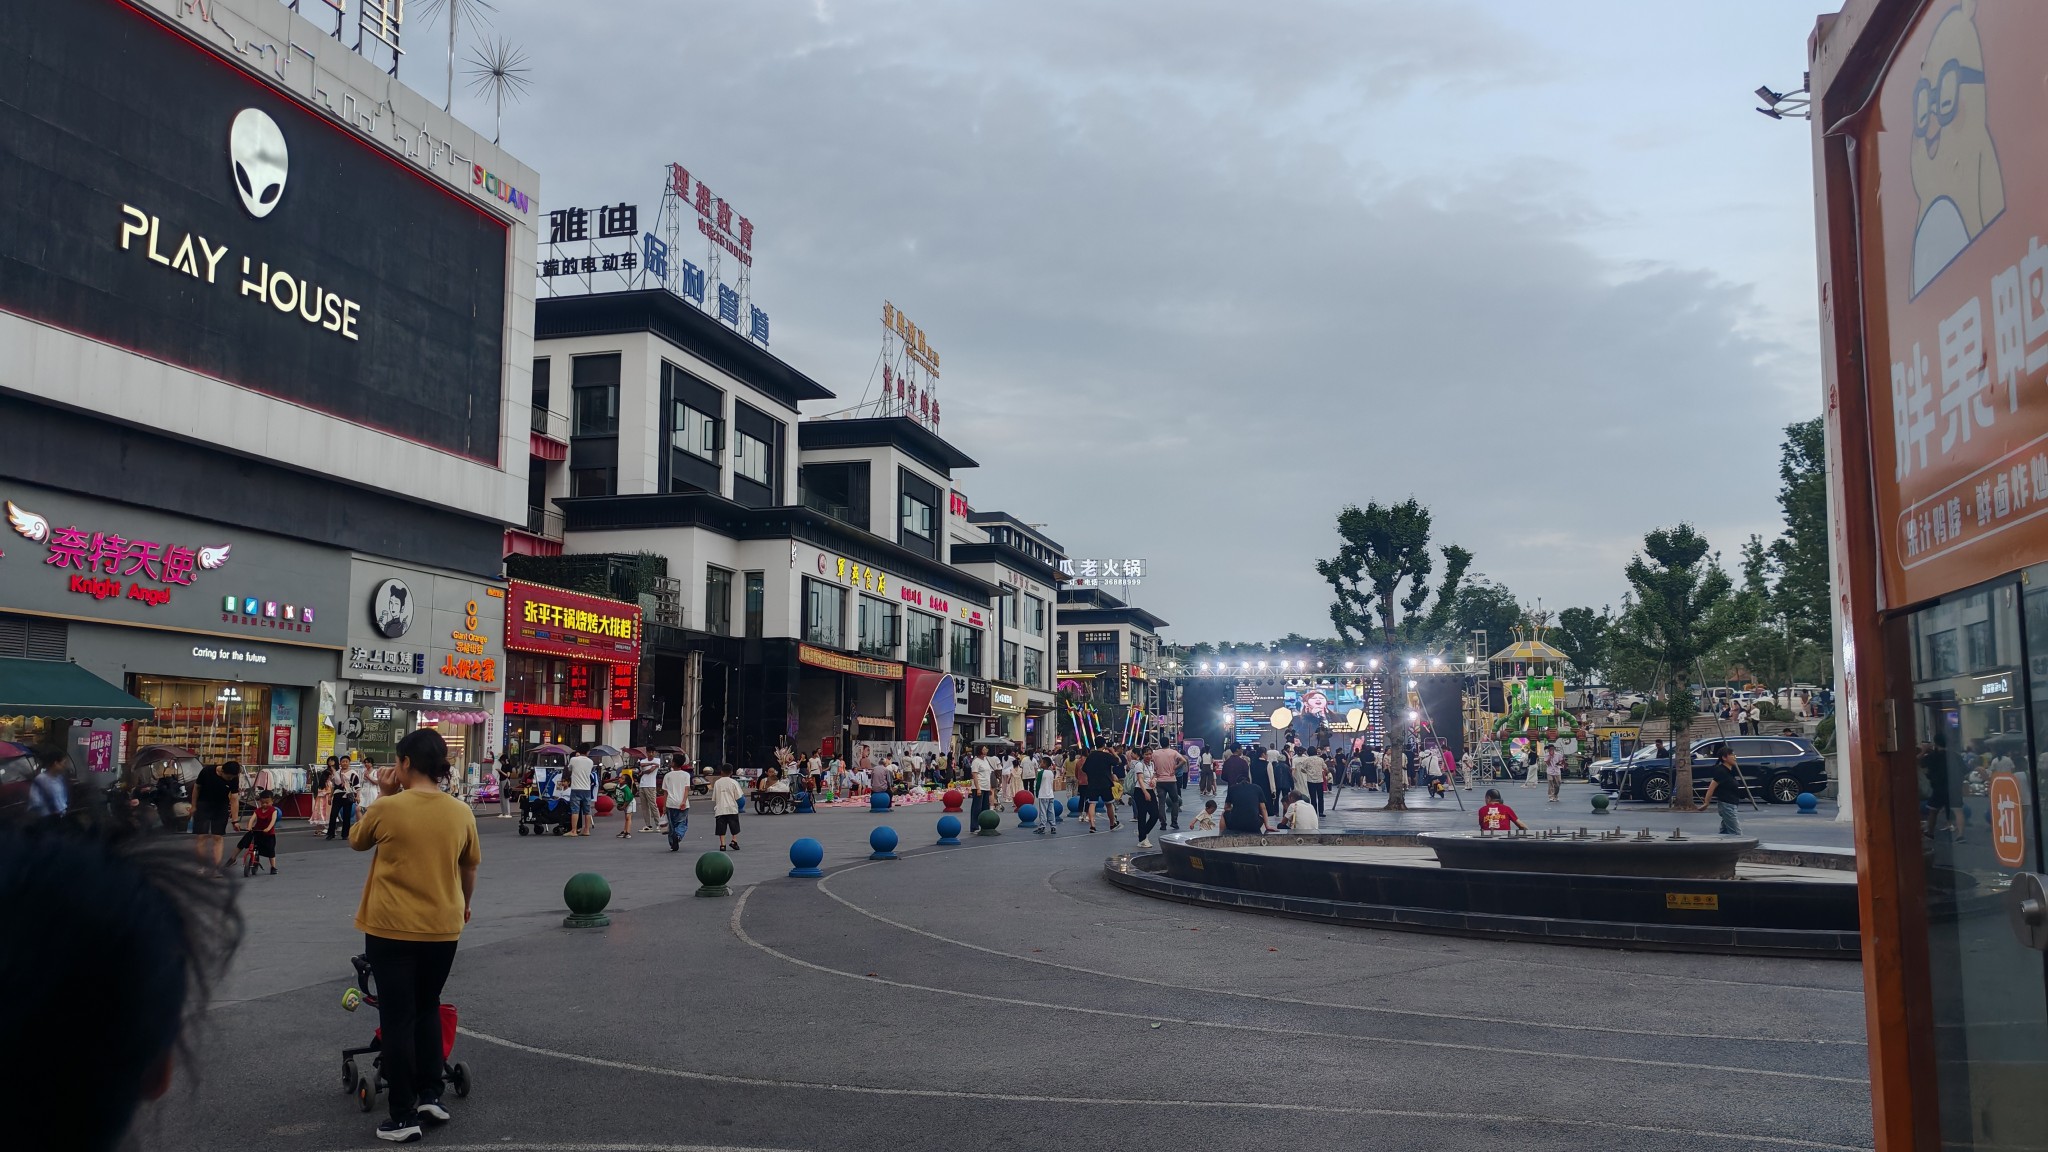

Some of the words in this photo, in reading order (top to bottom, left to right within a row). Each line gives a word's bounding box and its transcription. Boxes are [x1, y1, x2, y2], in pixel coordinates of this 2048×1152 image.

[473, 164, 530, 214] SICILIAN
[672, 162, 754, 250] 理想教育
[550, 202, 639, 244] 雅迪
[120, 203, 229, 284] PLAY
[240, 255, 361, 341] HOUSE
[536, 251, 638, 278] 端的电动车
[643, 232, 770, 347] 保利管道
[47, 525, 197, 586] 奈特天使
[1046, 558, 1142, 577] 瓜老火锅
[70, 574, 121, 600] Knight
[127, 582, 171, 607] Angel
[192, 647, 217, 660] Caring
[219, 649, 230, 659] for
[232, 650, 243, 661] the
[245, 651, 266, 664] future
[452, 630, 467, 640] Giant
[468, 633, 488, 644] Orange
[351, 647, 413, 666] 沪上阿姨
